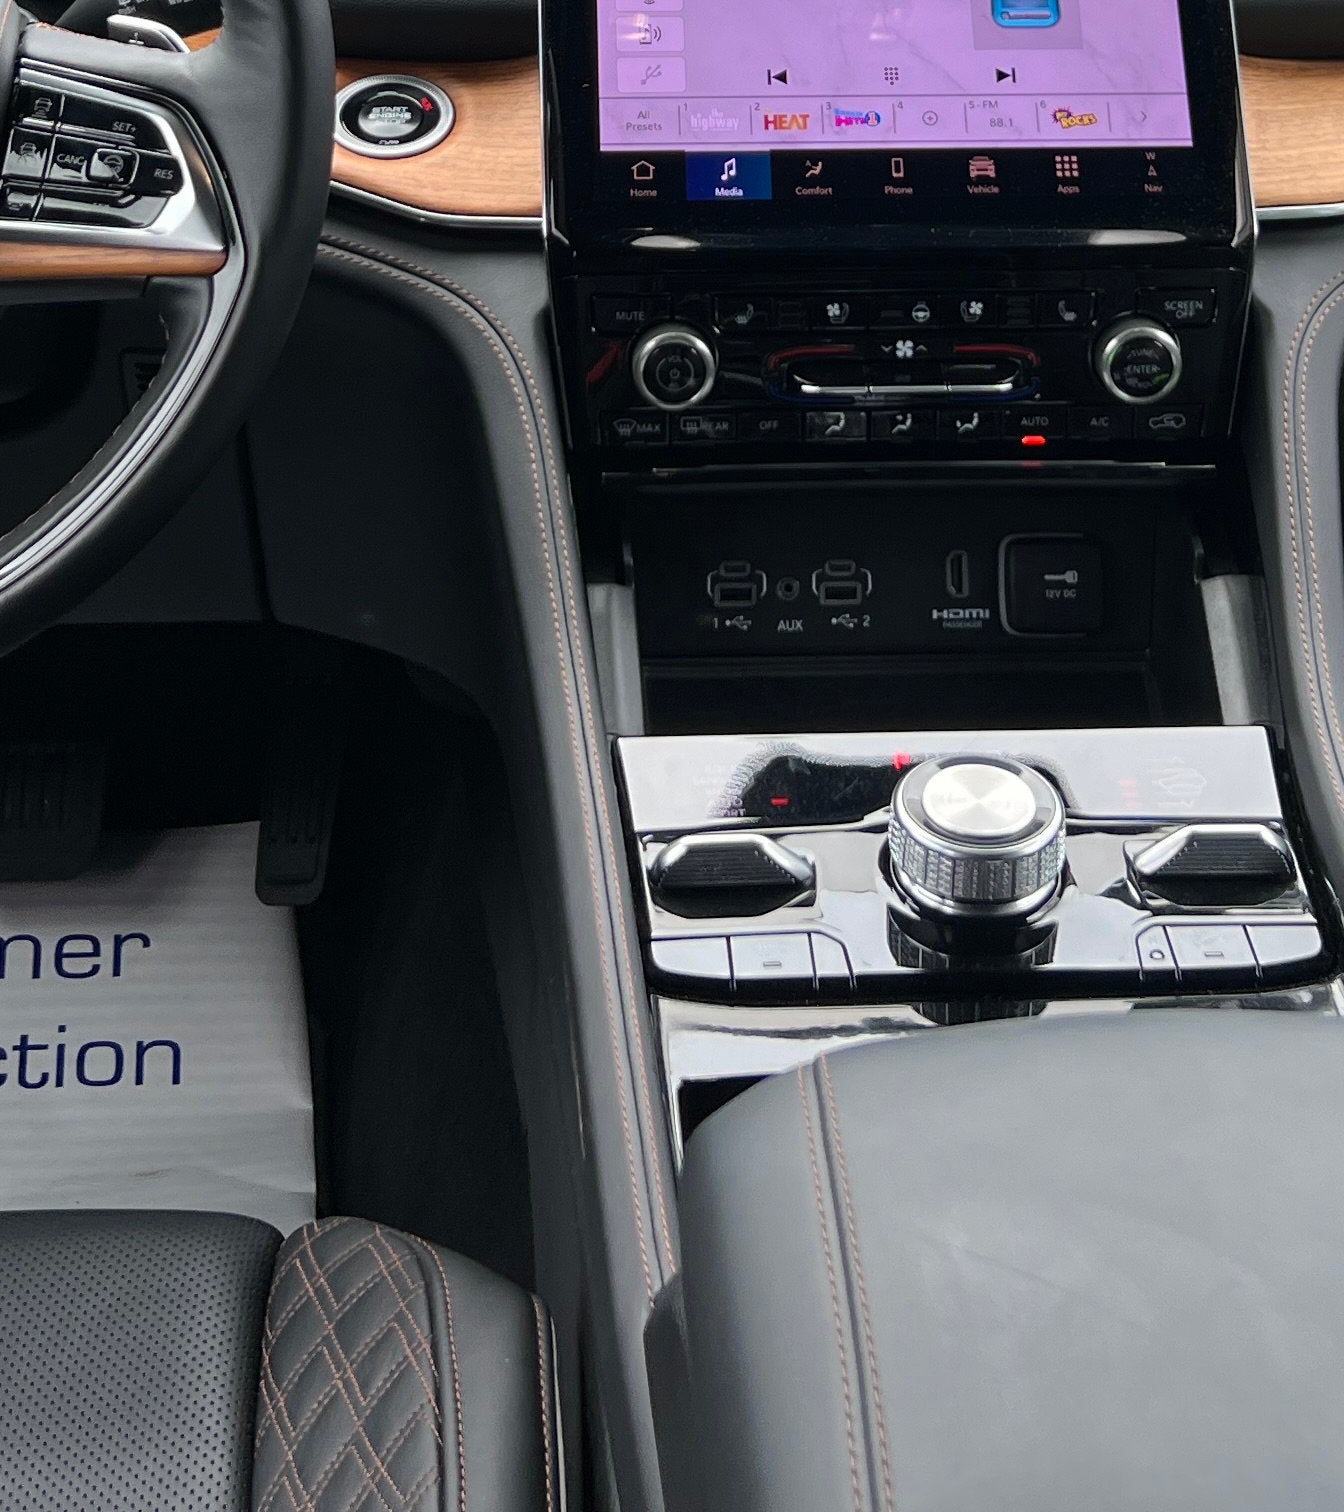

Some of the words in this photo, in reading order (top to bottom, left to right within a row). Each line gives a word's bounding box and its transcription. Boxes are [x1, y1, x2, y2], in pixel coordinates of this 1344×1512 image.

[754, 102, 760, 111] 2
[825, 102, 831, 110] 3
[896, 101, 903, 109] 4
[1040, 101, 1046, 109] 6
[637, 110, 650, 120] All
[625, 122, 663, 132] Presets
[690, 113, 740, 131] highway
[764, 113, 810, 131] HEAT
[989, 118, 1013, 127] 88.1
[57, 153, 85, 165] CANC
[1145, 152, 1156, 160] W
[154, 169, 173, 180] RES
[630, 188, 657, 197] Home
[715, 187, 744, 197] Media
[795, 186, 833, 196] Comfort
[884, 185, 913, 195] Phone
[967, 184, 1000, 194] Vehicle
[1057, 184, 1080, 195] Apps
[1144, 184, 1163, 193] Nav
[1164, 300, 1204, 310] SCREEN
[615, 311, 645, 321] MUTE
[1176, 309, 1195, 319] OFF
[1127, 364, 1157, 374] ENTER
[759, 420, 779, 431] OFF
[1021, 416, 1049, 427] AUTO
[1090, 416, 1109, 427] A/C
[636, 422, 661, 433] MAX
[1045, 589, 1061, 598] 12V
[1064, 589, 1076, 598] DC
[932, 608, 990, 619] HDMI
[713, 617, 719, 629] 1
[777, 619, 804, 632] AUX
[862, 615, 871, 627] 2
